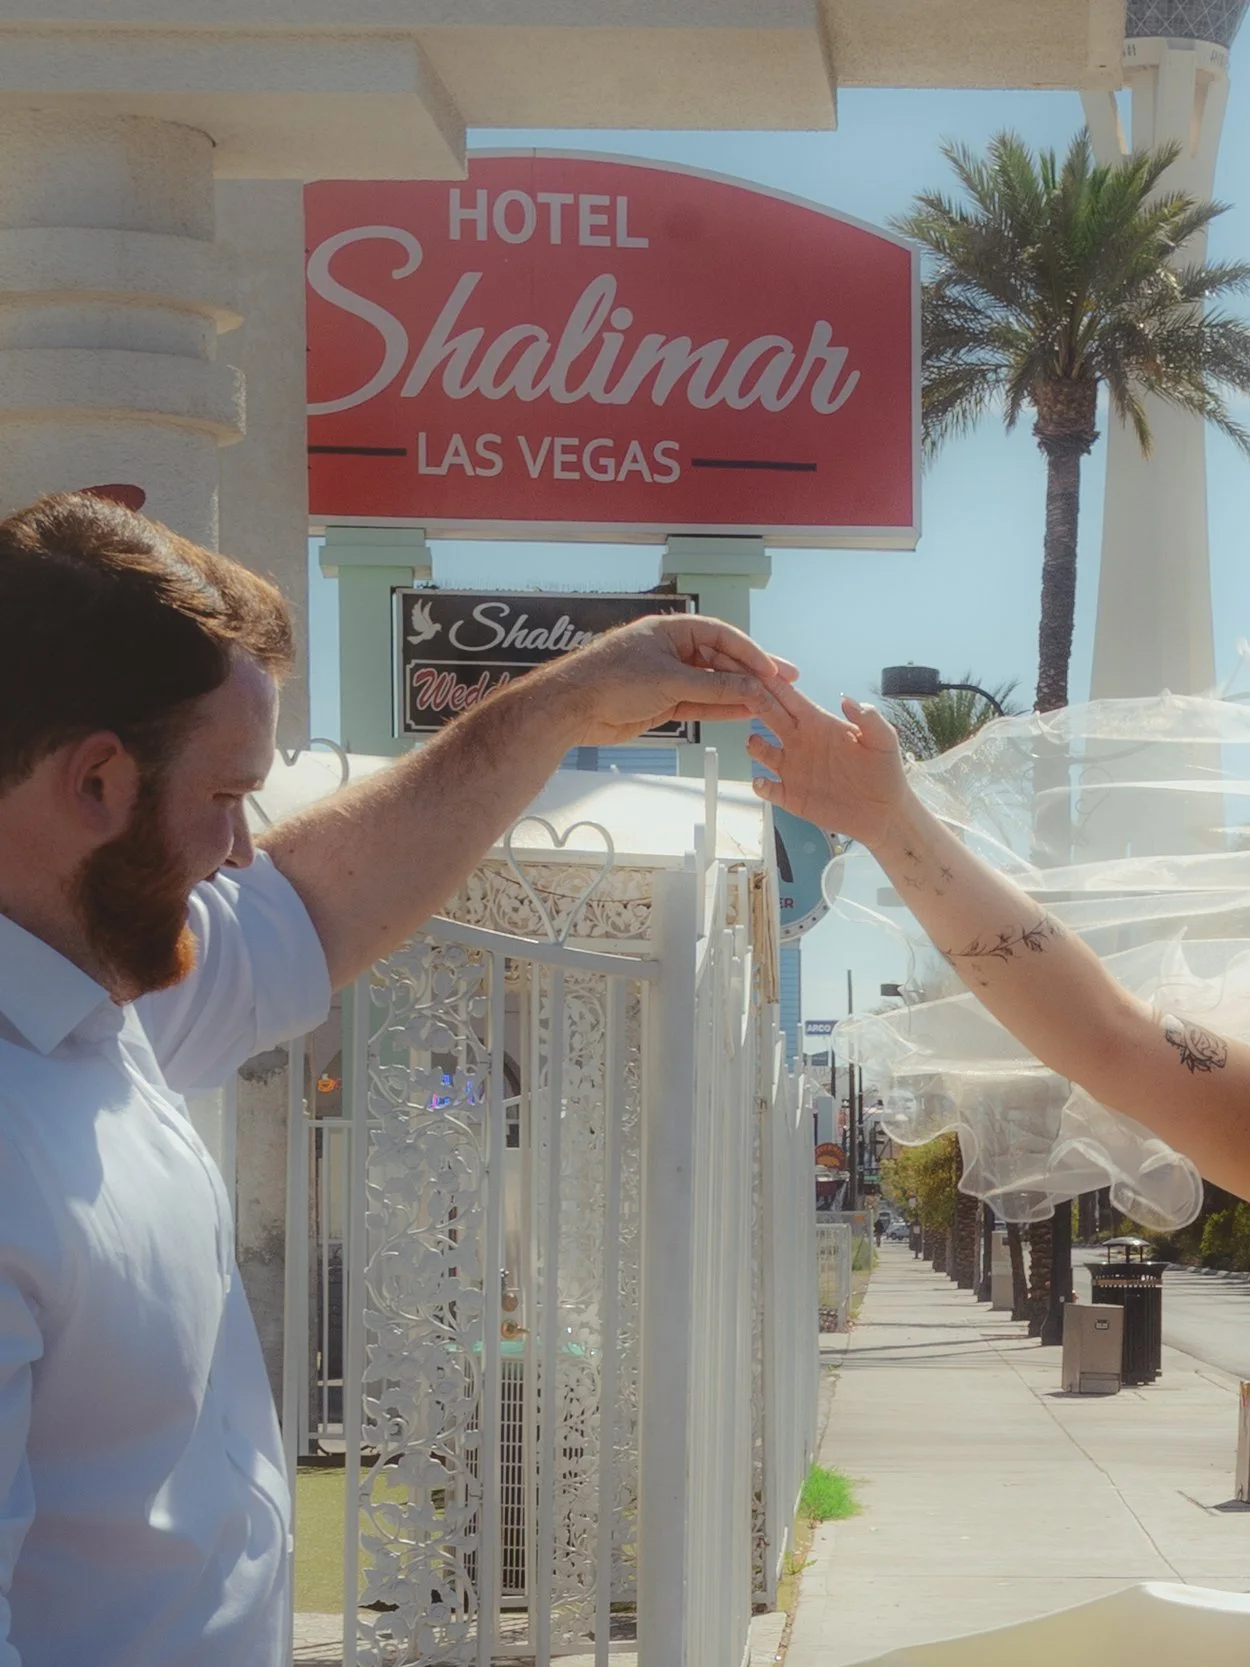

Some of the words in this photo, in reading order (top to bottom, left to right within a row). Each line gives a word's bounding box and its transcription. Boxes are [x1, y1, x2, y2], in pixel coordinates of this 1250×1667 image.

[448, 188, 649, 249] HOTEL
[307, 226, 861, 415] Shalimar
[417, 432, 503, 477] LAS
[517, 436, 682, 484] VEGAS
[806, 1023, 832, 1033] ARCO
